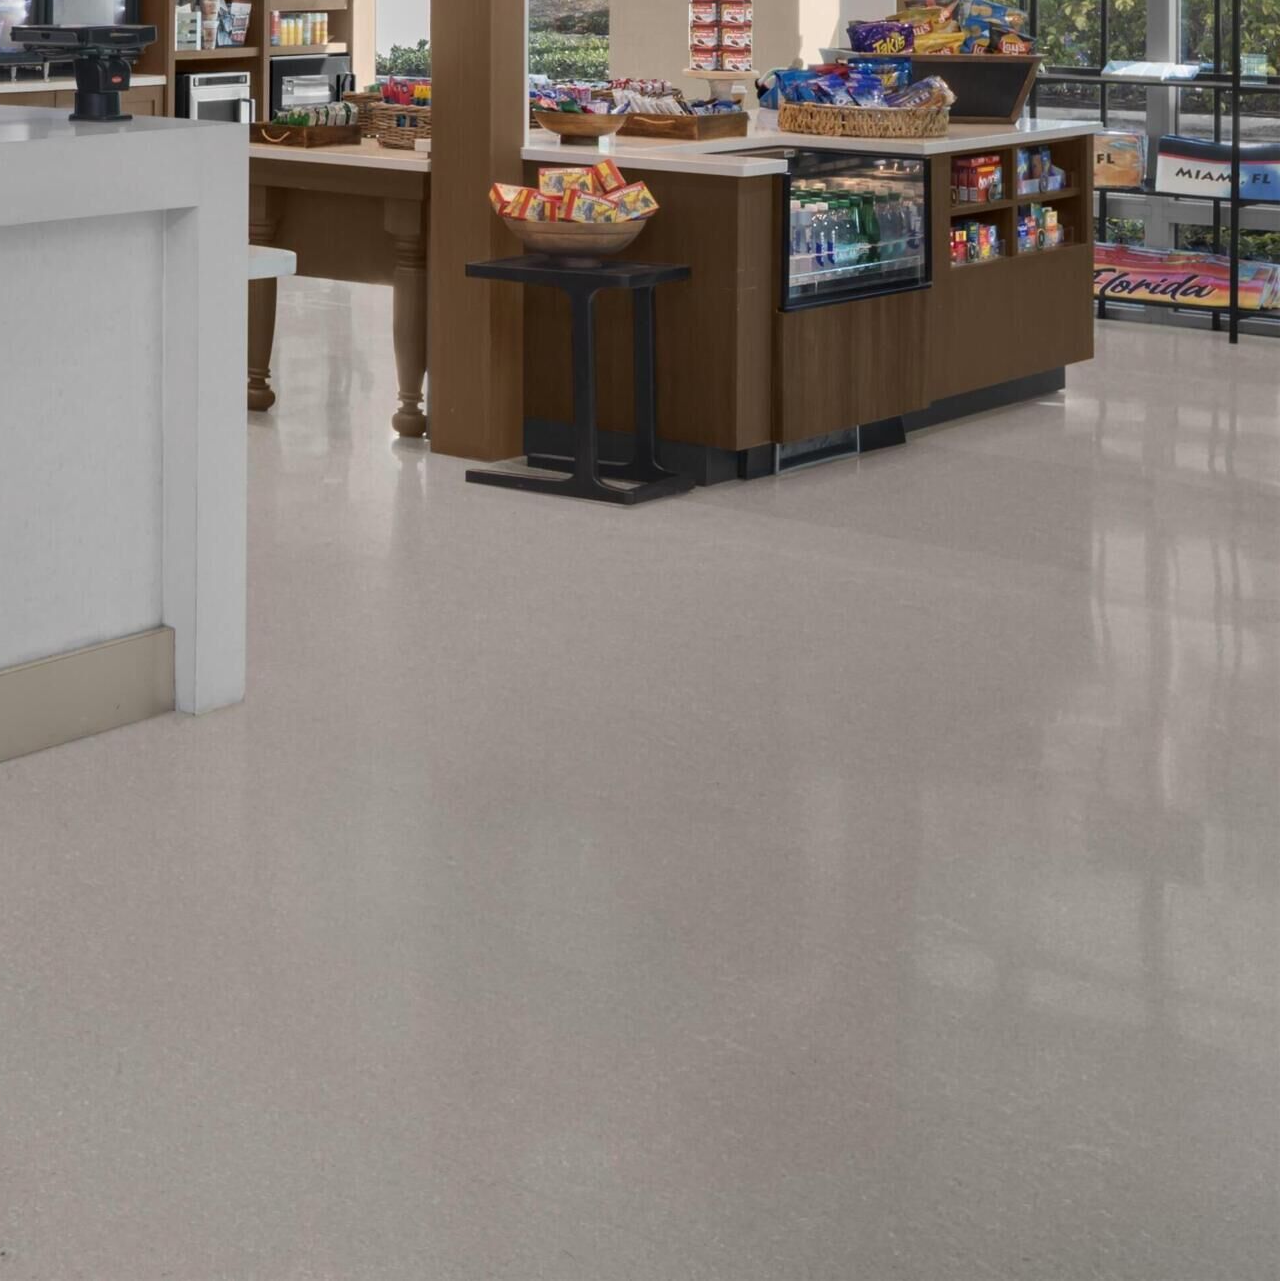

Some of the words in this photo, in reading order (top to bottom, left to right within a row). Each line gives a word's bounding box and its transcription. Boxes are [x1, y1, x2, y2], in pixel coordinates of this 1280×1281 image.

[1002, 39, 1026, 55] Lay's
[1096, 153, 1115, 165] FL
[1251, 173, 1272, 185] FL
